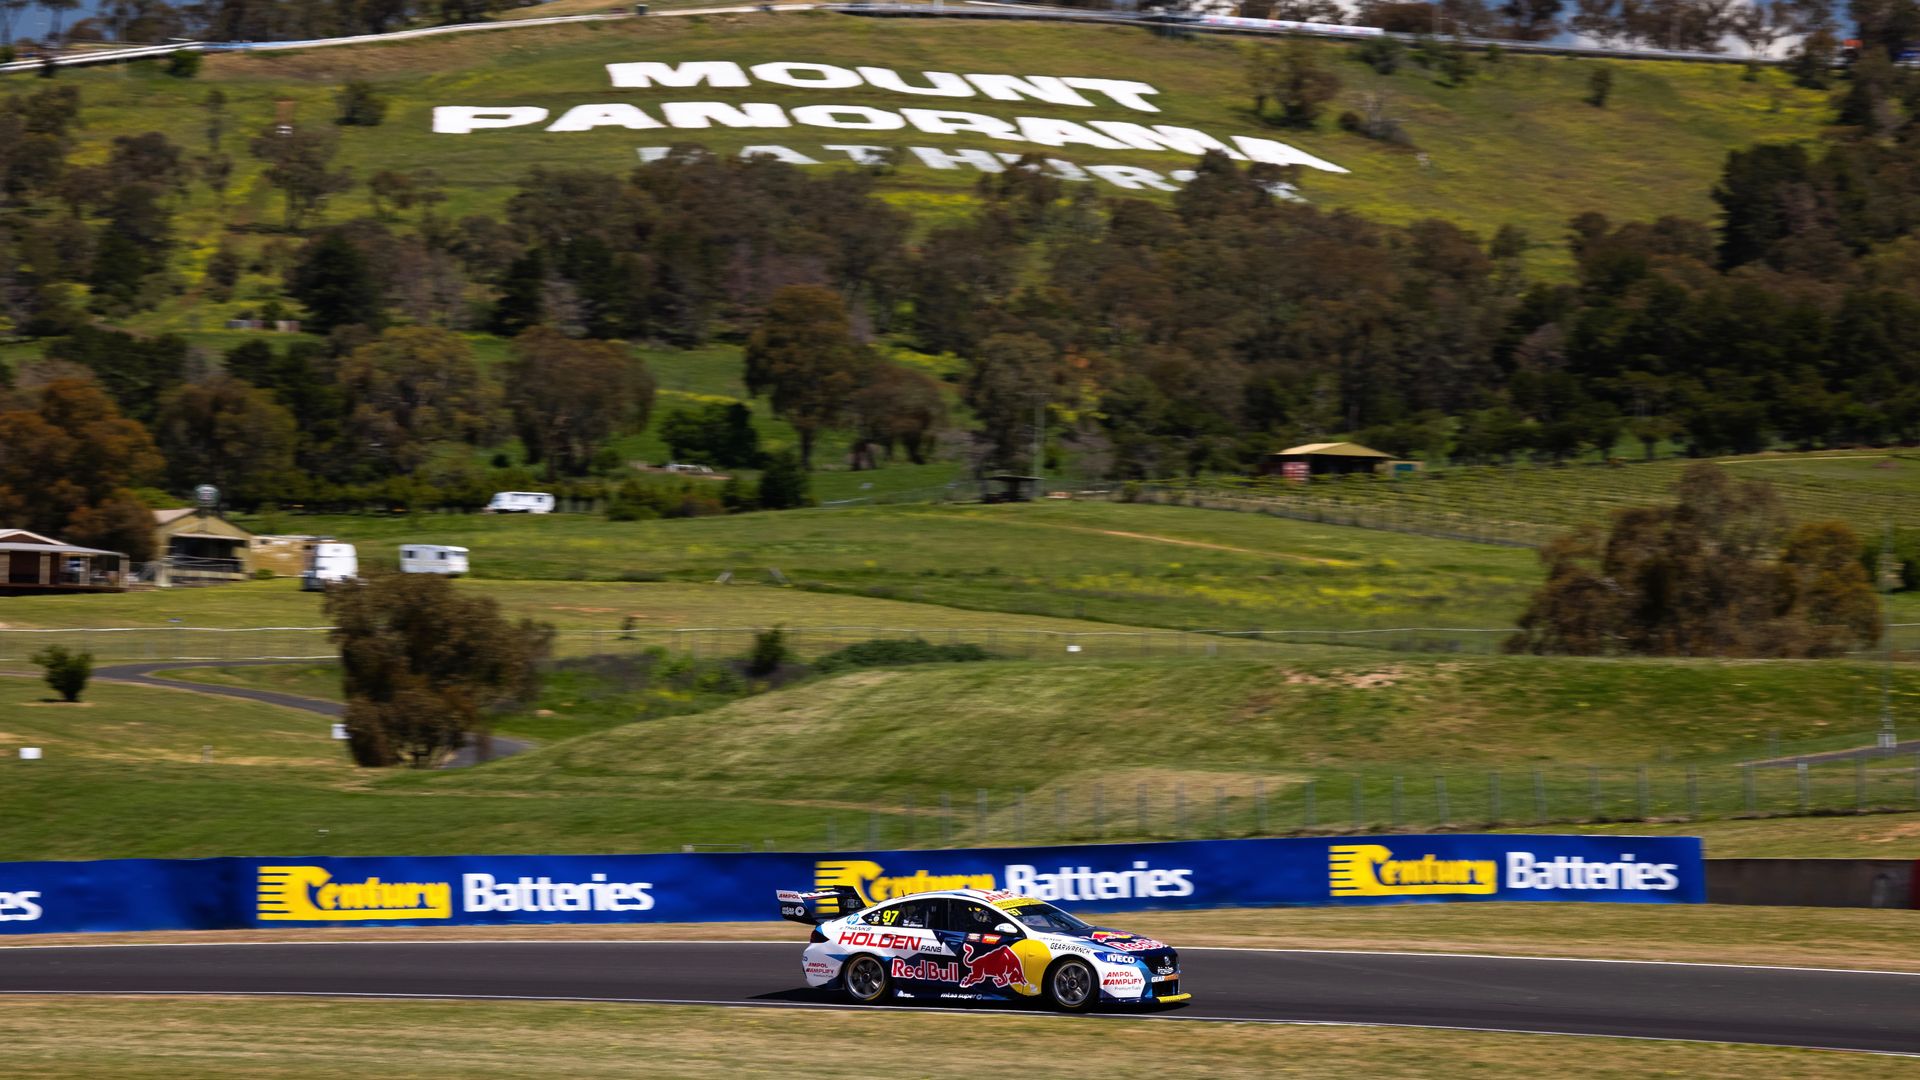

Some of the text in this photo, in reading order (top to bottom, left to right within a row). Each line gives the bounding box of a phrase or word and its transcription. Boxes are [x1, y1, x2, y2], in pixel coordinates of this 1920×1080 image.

[606, 60, 1160, 112] MOUNT
[432, 101, 1350, 173] PANORAMA
[1005, 860, 1194, 901] Batteries
[1329, 844, 1679, 896] Century Batteries
[257, 866, 656, 920] Century Batteries
[779, 892, 800, 900] AMPOL
[882, 909, 900, 924] 97
[839, 931, 942, 953] HOLDEN FANS
[1050, 942, 1091, 954] GEARWRENCH
[892, 958, 959, 982] Red Bull
[1106, 954, 1135, 964] IVECO
[1109, 978, 1143, 986] AMPLIFY
